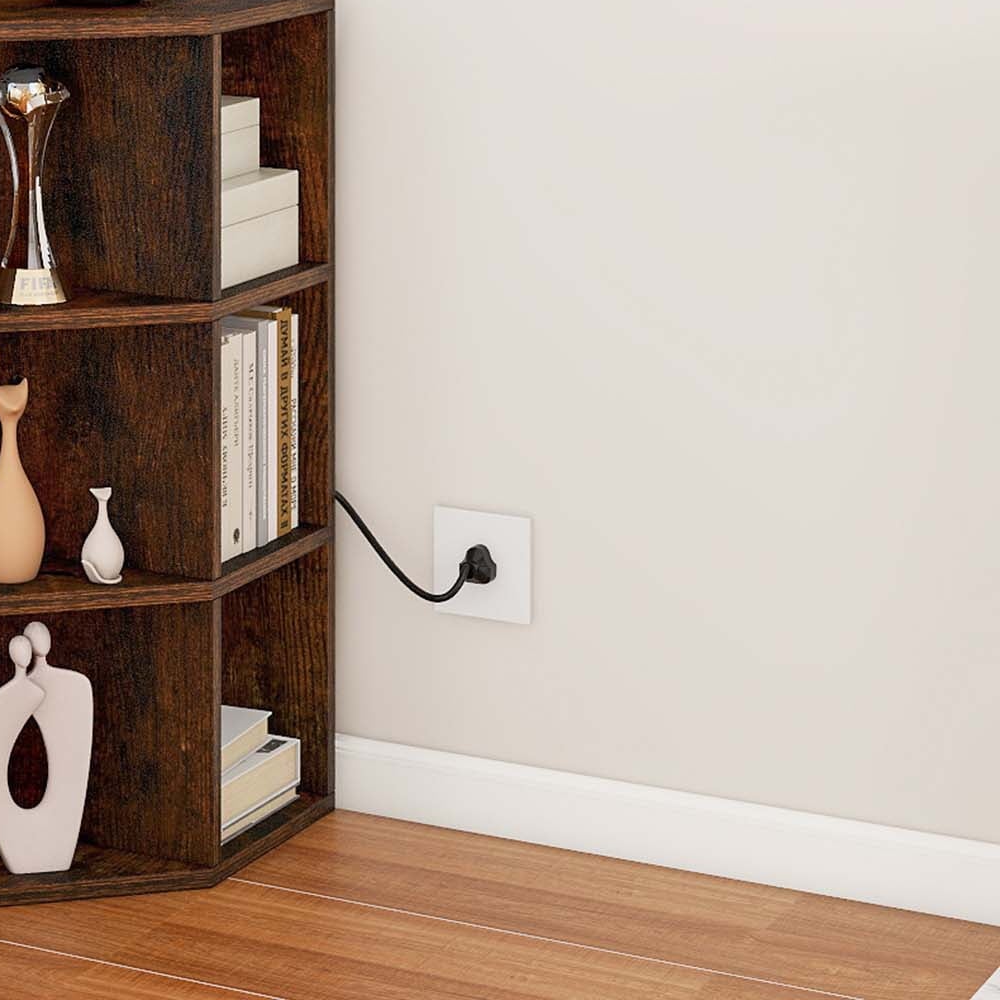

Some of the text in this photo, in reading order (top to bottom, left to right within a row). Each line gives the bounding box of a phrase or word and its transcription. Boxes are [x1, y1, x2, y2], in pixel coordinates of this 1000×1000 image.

[280, 319, 290, 367] ДУМАЙ
[280, 385, 289, 439] ДРУГИХ
[279, 442, 289, 517] ФОРМАТАХ
